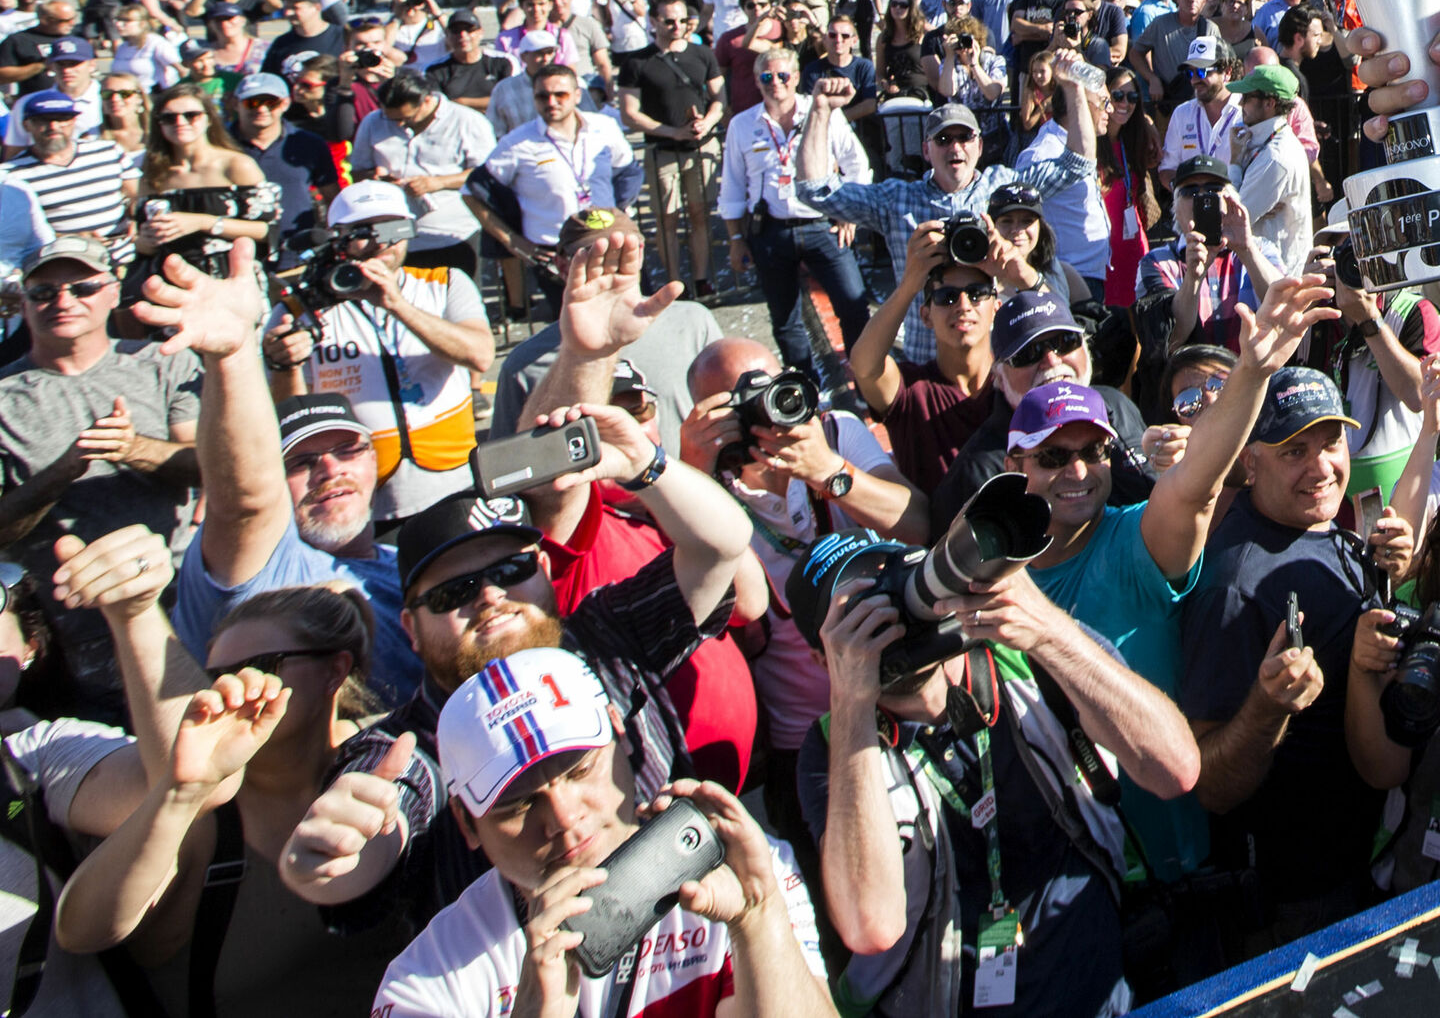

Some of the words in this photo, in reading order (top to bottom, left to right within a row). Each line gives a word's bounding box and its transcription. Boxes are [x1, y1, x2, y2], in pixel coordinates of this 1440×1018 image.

[313, 340, 361, 365] 100
[485, 690, 534, 721] TOYOTA
[541, 673, 571, 709] 1
[488, 697, 537, 730] HYBRID
[1071, 727, 1099, 773] Canon
[638, 926, 706, 960] DENSO
